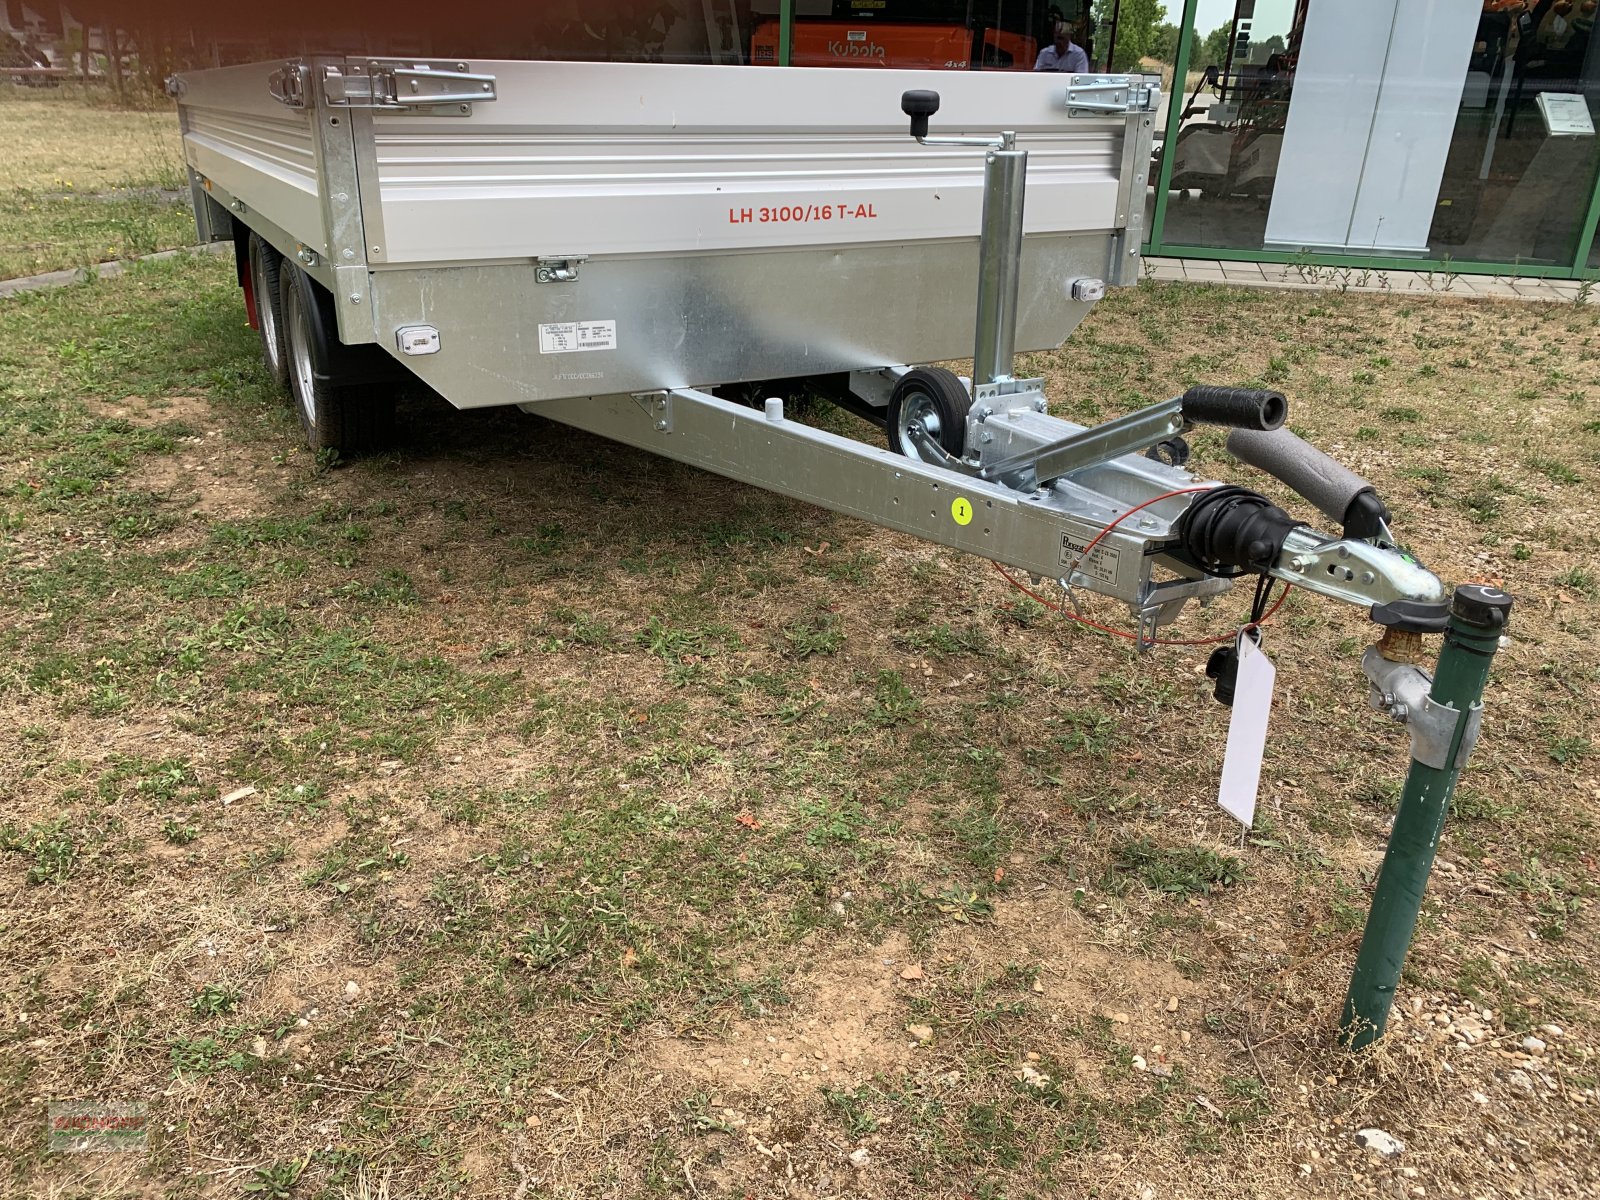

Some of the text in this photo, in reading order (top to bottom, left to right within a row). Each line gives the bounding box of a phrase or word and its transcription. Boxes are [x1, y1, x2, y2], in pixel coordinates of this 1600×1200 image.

[828, 41, 885, 58] Kubota
[729, 203, 878, 223] LH 3100/16 T-AL
[959, 506, 965, 517] 1
[1063, 535, 1087, 552] Pongrat
